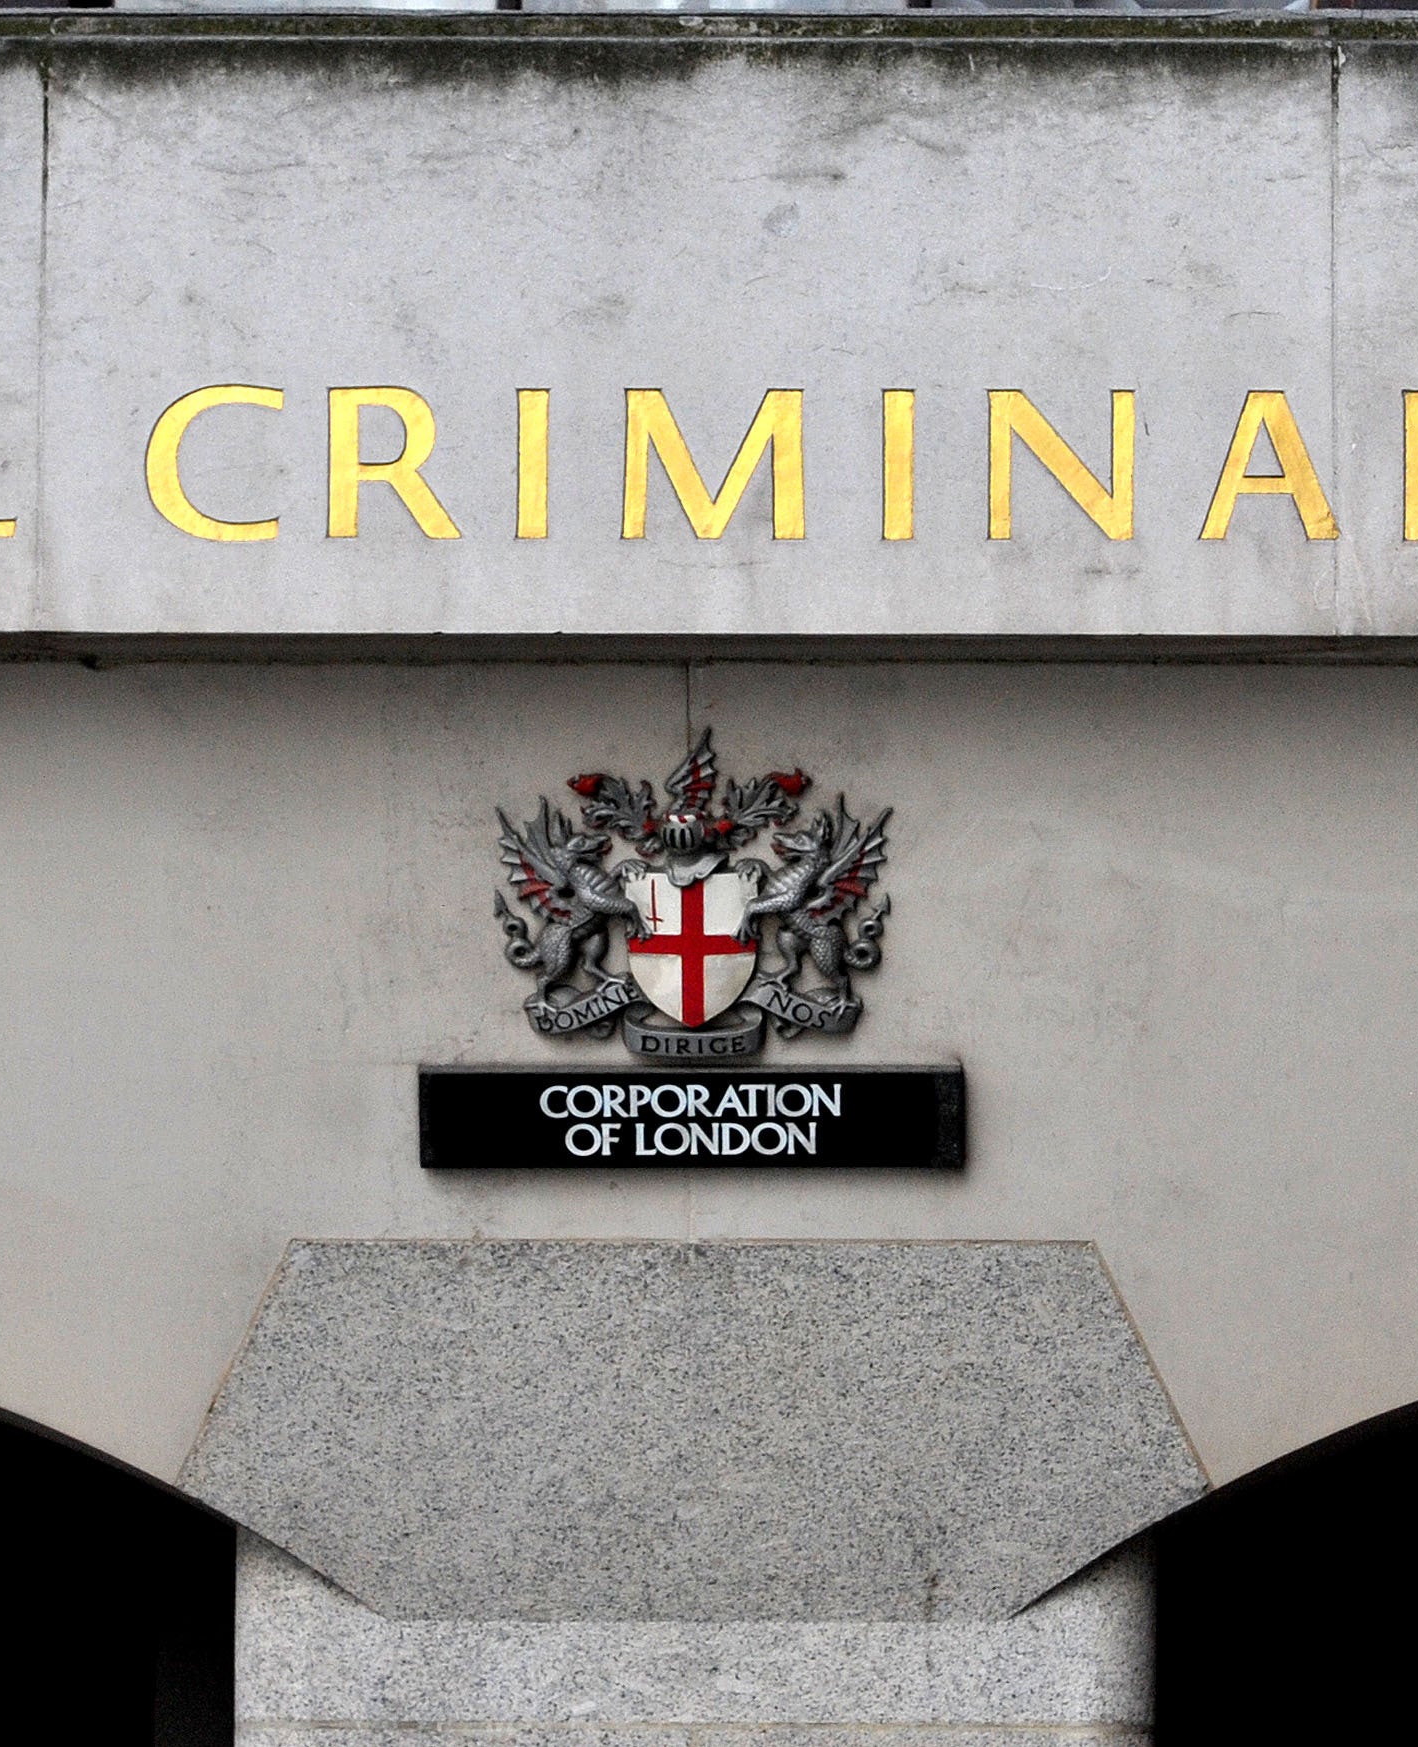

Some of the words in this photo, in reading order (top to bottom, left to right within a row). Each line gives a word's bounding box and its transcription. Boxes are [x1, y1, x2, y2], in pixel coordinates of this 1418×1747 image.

[641, 1035, 745, 1054] DIRIGE
[766, 990, 831, 1028] NOS
[539, 1083, 842, 1118] CORPORATION
[564, 1122, 622, 1156] OF
[634, 1121, 817, 1156] LONDON
